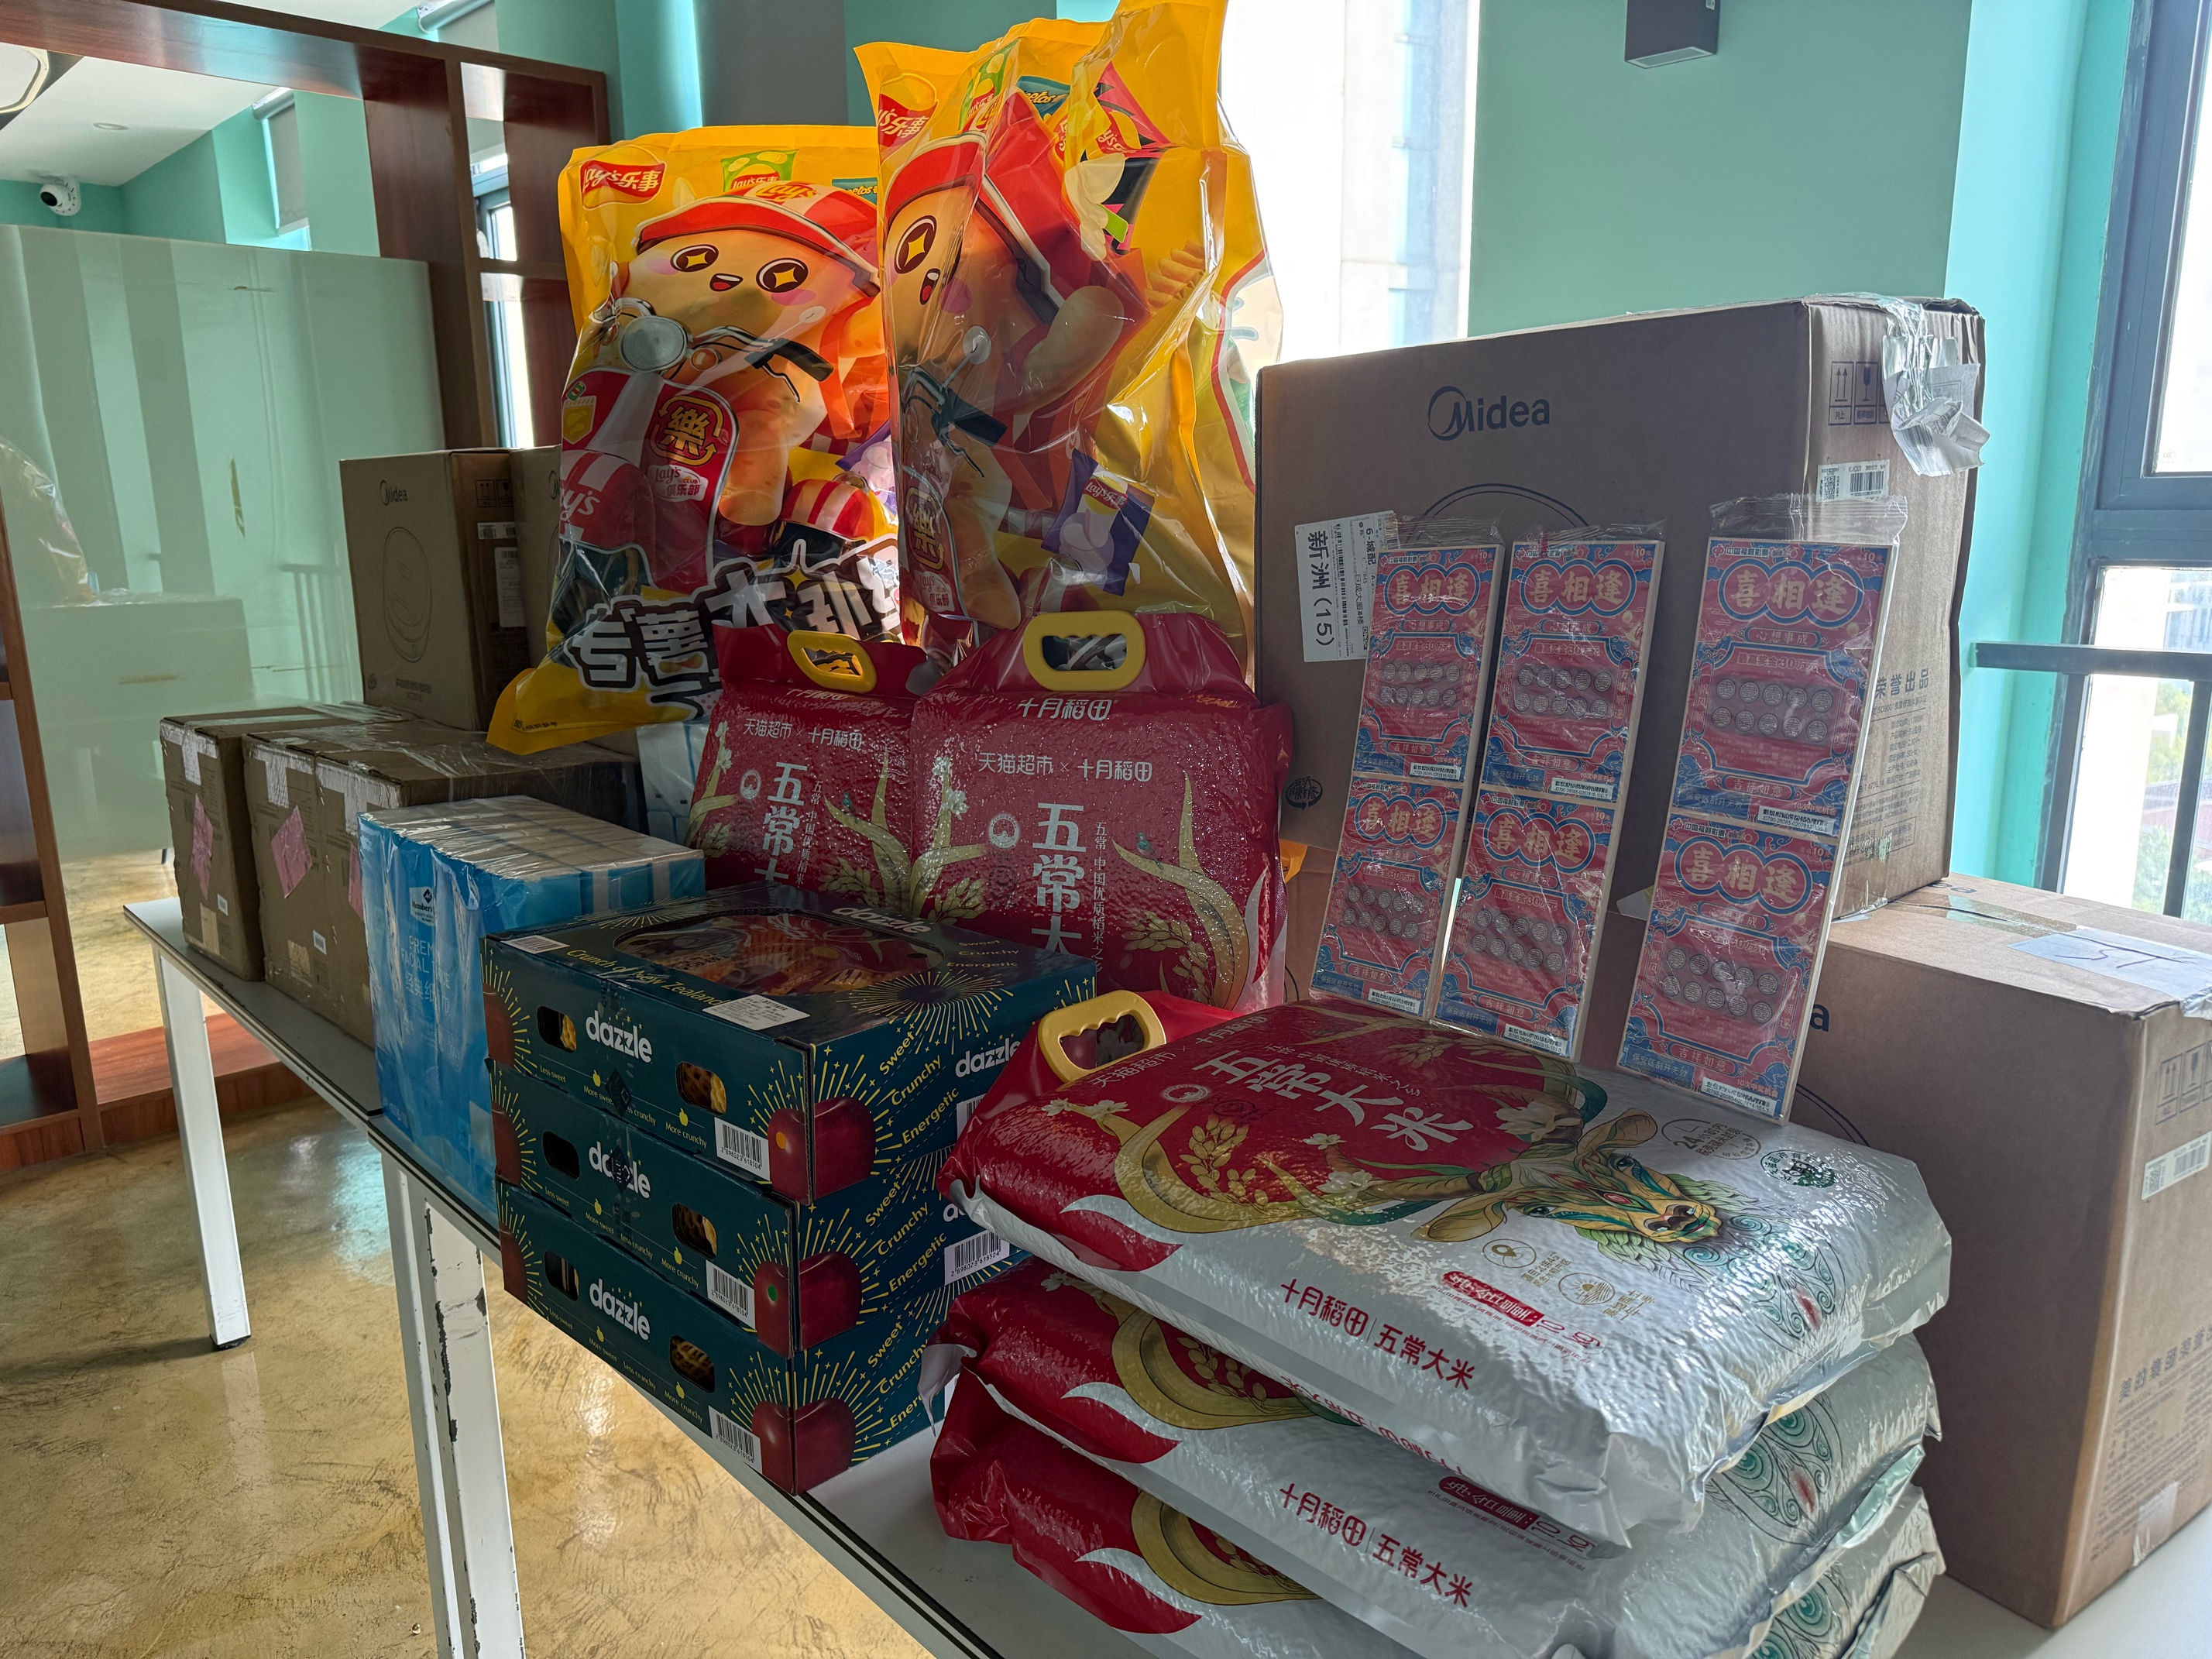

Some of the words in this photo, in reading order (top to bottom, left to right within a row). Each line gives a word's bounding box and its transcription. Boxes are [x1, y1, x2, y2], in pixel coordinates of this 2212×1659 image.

[878, 108, 929, 139] 's乐事
[1427, 386, 1551, 441] Midea
[660, 406, 712, 457] 樂
[654, 467, 682, 484] Lay's
[667, 483, 701, 496] 俱乐部
[379, 479, 408, 507] Midea
[1365, 527, 1376, 565] 6-城配
[1392, 572, 1469, 606] 喜相逢
[1529, 569, 1624, 605] 喜相逢
[1730, 569, 1848, 615] 喜相逢
[1757, 630, 1808, 645] 心想事成
[1737, 653, 1819, 672] 最高奖金30万元
[1614, 669, 1630, 720] 万事顺遂
[1874, 668, 1929, 699] 荣誉出品
[1018, 698, 1112, 721] 十月稻田
[744, 718, 793, 739] 天猫超市
[808, 727, 863, 749] 十月稻田
[1393, 743, 1427, 754] 吉祥如意
[979, 752, 1053, 775] 天猫超市
[1077, 759, 1152, 782] 十月稻田
[1530, 755, 1571, 769] 吉祥如意
[1685, 792, 1743, 810] 保安区刮开无效
[1733, 778, 1783, 798] 吉祥如意
[1365, 801, 1437, 839] 喜相逢
[1794, 802, 1836, 816] 10次中奖机会
[1492, 816, 1583, 863] 喜相逢
[1685, 823, 1726, 839] 中国福利彩票
[1510, 871, 1550, 886] 心想事成
[1686, 846, 1796, 903] 喜相逢
[1494, 888, 1558, 910] 最高奖金30万元
[832, 905, 932, 934] dazzle
[1710, 907, 1757, 928] 心想事成
[566, 948, 615, 969] Crunch
[946, 960, 1019, 968] Energetic
[1647, 939, 1663, 988] 一帆风顺
[1354, 967, 1387, 983] 吉祥如意
[1446, 1006, 1493, 1025] 保安区刮开无效
[1485, 999, 1526, 1018] 吉祥如意
[586, 1010, 654, 1063] dazzle
[1087, 1050, 1176, 1087] 天猫超市
[1195, 1015, 1269, 1045] 十月稻田
[878, 1030, 915, 1076] Sweet
[1632, 1053, 1688, 1078] 保安区刮开无效
[1679, 1047, 1728, 1073] 吉祥如意
[583, 1085, 597, 1097] More
[598, 1090, 614, 1106] swee
[891, 1055, 943, 1107] Crunchy
[1736, 1079, 1779, 1098] 10次中奖机会
[1191, 1049, 1474, 1152] 五常大米
[634, 1109, 657, 1127] crunchy
[902, 1087, 960, 1145] Energetic
[665, 1121, 682, 1136] More
[682, 1127, 708, 1149] crunchy
[1673, 1122, 1728, 1150] 24小时内
[588, 1141, 651, 1199] dale
[865, 1181, 900, 1227] Sweet
[586, 1211, 598, 1224] More
[598, 1218, 614, 1235] sweet
[877, 1201, 929, 1256] Crunchy
[620, 1233, 633, 1246] Less
[633, 1238, 653, 1260] crunchy
[661, 1257, 676, 1273] More
[676, 1265, 699, 1290] crunchy
[888, 1231, 948, 1293] Energetic
[956, 1261, 978, 1276] 898023
[979, 1252, 1001, 1265] 618504
[589, 1278, 651, 1341] dazzle
[867, 1321, 903, 1369] Sweet
[1279, 1278, 1369, 1337] 十月稻田
[1373, 1323, 1476, 1390] 五常大米
[623, 1361, 635, 1374] Less
[635, 1368, 657, 1391] crunchy
[879, 1340, 928, 1395] Crunchy
[665, 1390, 680, 1407] More
[679, 1398, 704, 1424] crunchy
[1279, 1482, 1367, 1547] 十月稻田
[1372, 1533, 1474, 1609] 五常大米
